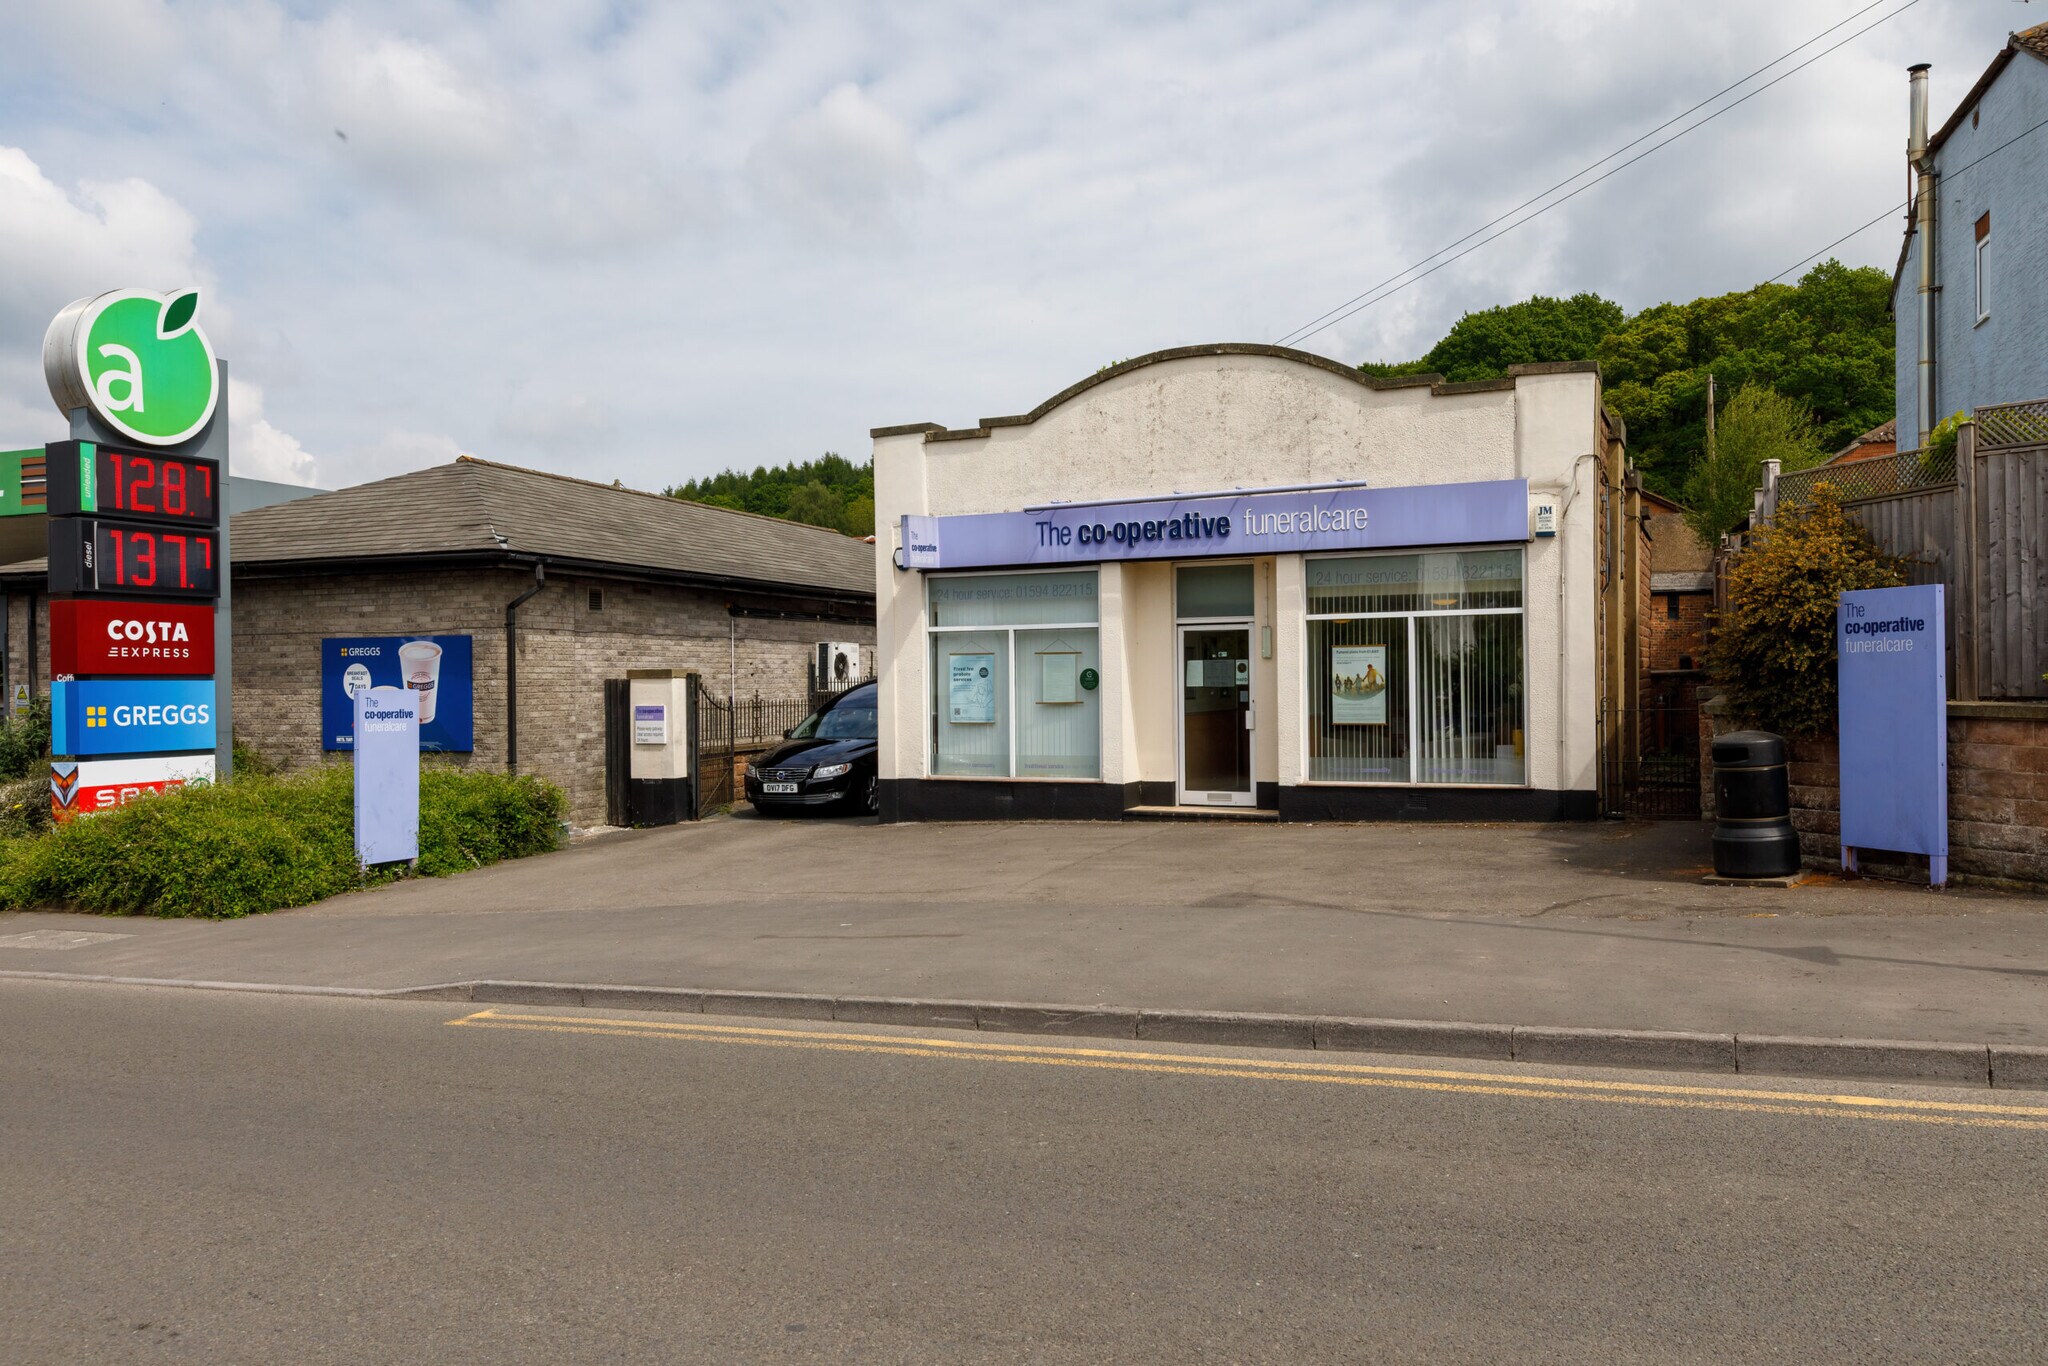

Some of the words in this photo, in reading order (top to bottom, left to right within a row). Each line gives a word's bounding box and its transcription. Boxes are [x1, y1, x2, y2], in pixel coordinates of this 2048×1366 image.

[83, 457, 92, 498] unleaded
[1538, 506, 1553, 516] JM
[1035, 521, 1072, 547] The
[1078, 511, 1232, 548] co-operative
[1243, 504, 1368, 535] funeralcare
[84, 541, 93, 568] diesel
[911, 543, 937, 553] co-operative
[1316, 570, 1331, 585] 24
[1335, 568, 1362, 584] hour
[1366, 567, 1412, 583] service:
[937, 588, 950, 601] 24
[952, 587, 974, 601] hour
[976, 586, 1014, 600] service:
[1016, 584, 1049, 599] 01594
[1052, 581, 1093, 598] 822115
[1844, 602, 1865, 618] The
[107, 619, 189, 644] COSTA
[1844, 616, 1925, 636] co-operative
[121, 647, 190, 658] EXPRESS
[348, 647, 381, 657] GREGGS
[1844, 637, 1914, 653] funeralcare
[348, 682, 355, 694] 7
[364, 697, 379, 709] The
[113, 704, 209, 727] GREGGS
[364, 708, 414, 721] co-operative
[364, 720, 407, 732] funeralcare
[781, 784, 795, 792] DFG
